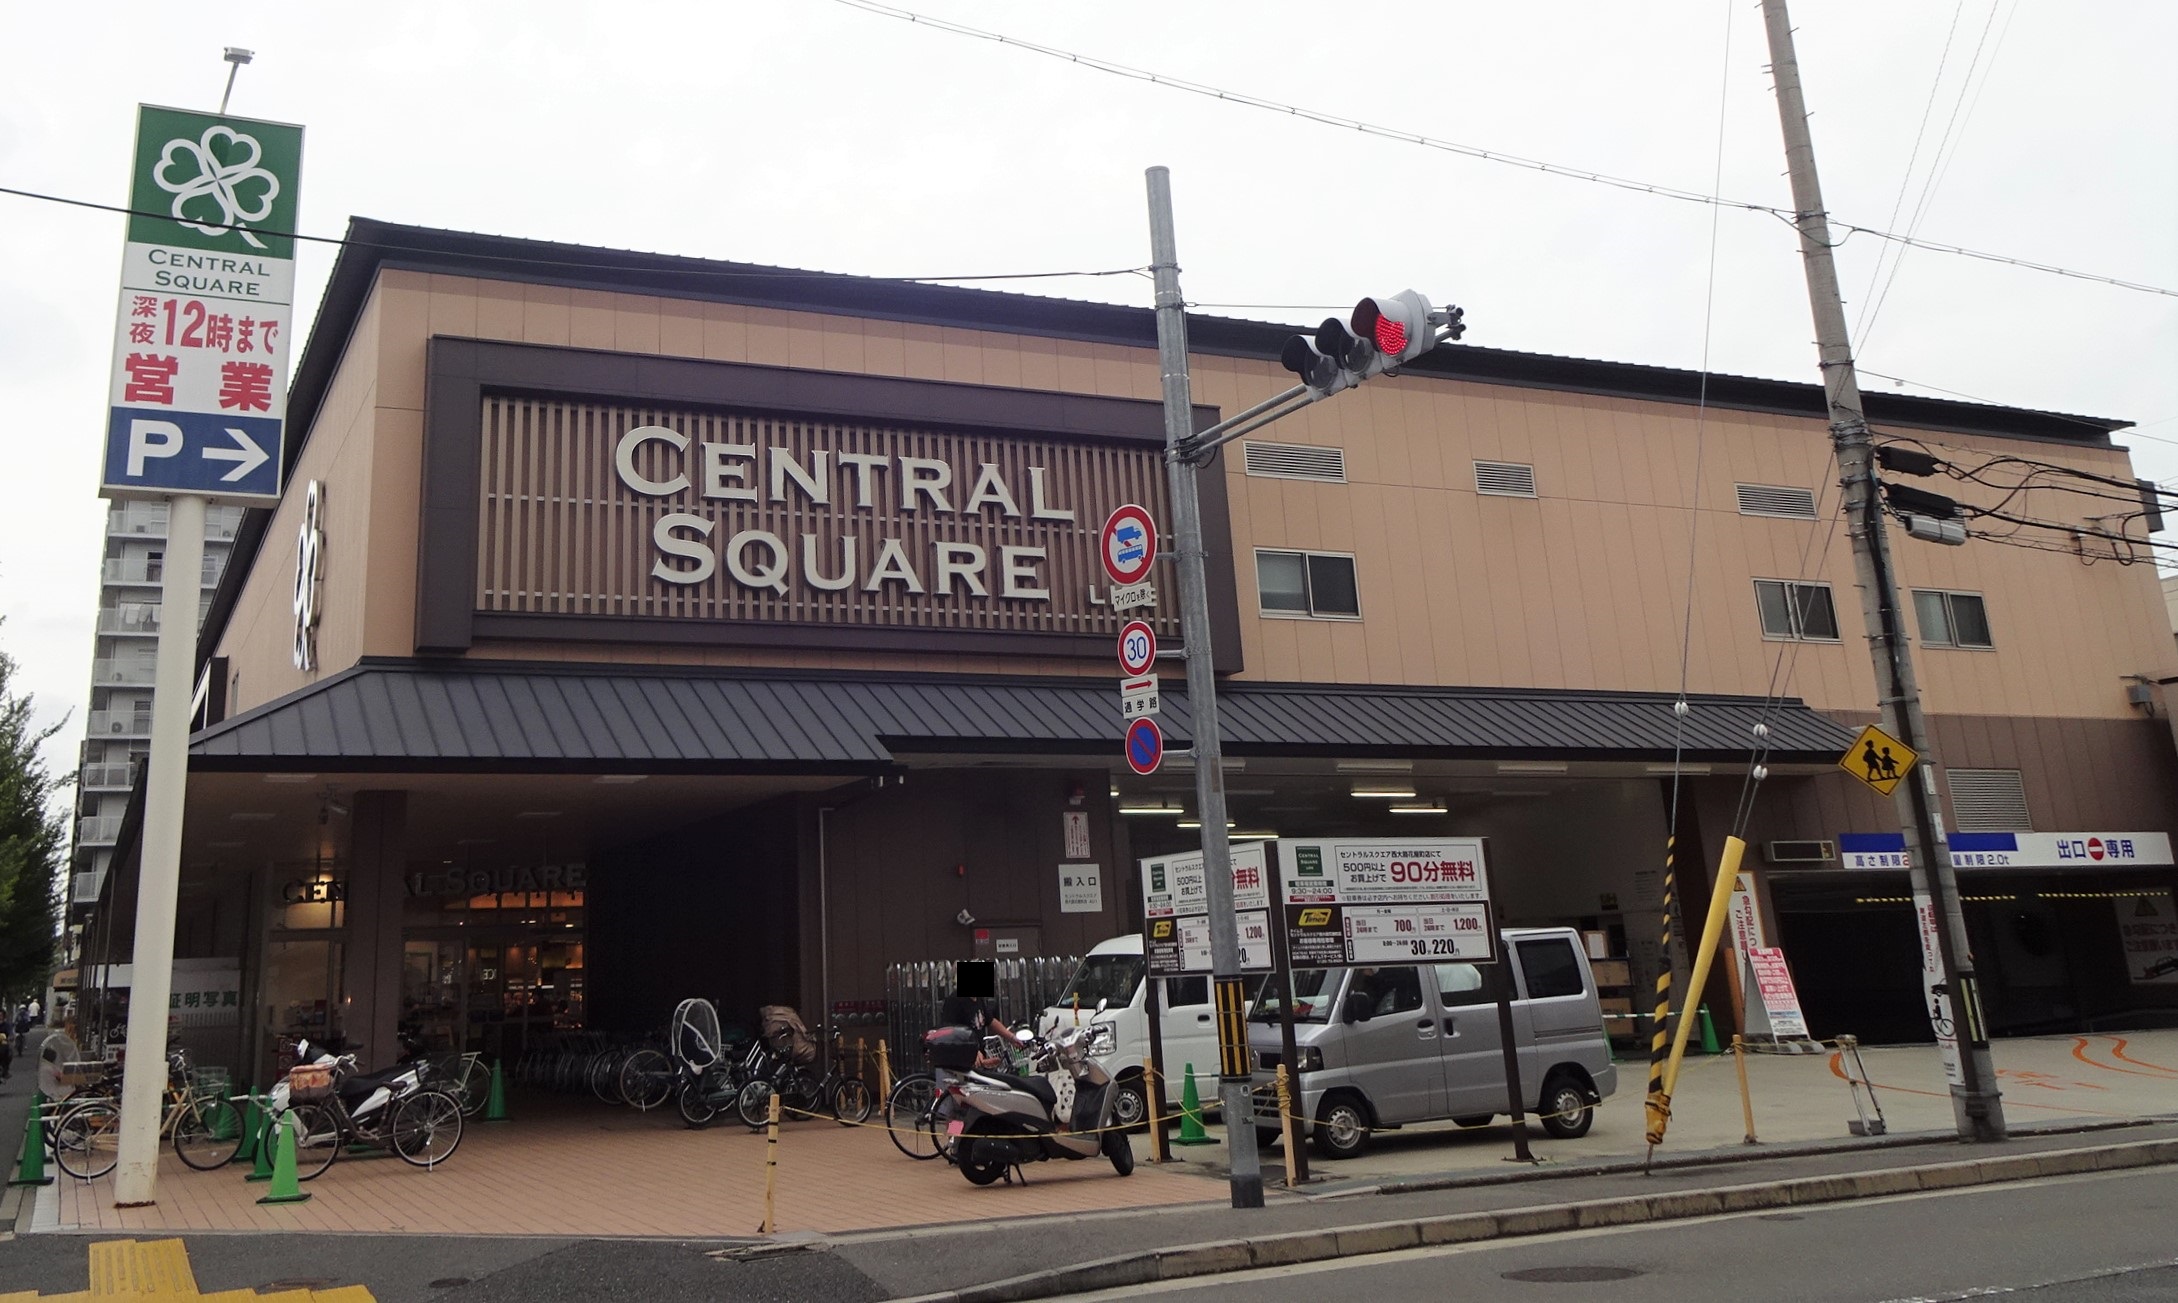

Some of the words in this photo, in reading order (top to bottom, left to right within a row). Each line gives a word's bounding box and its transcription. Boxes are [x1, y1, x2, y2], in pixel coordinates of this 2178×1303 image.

[148, 248, 271, 278] CENTRAL
[154, 270, 261, 297] SQUARE
[129, 295, 158, 346] 深夜
[162, 299, 280, 355] 12時まで
[124, 352, 274, 412] 営業
[126, 418, 185, 477] P
[615, 424, 1075, 524] CENTRAL
[651, 512, 1051, 603] SQUARE
[1114, 588, 1150, 607] マイクロを除く
[1126, 635, 1147, 662] 30
[1123, 696, 1158, 715] 通学路
[1855, 853, 1910, 867] 高さ制限2
[1952, 853, 2009, 867] 量制限2.0t
[2057, 839, 2086, 859] 出口
[2106, 839, 2135, 858] 専用
[447, 864, 587, 895] SQUARE
[1232, 865, 1260, 890] 無料
[1343, 862, 1386, 872] 500円以上
[1350, 873, 1387, 883] お買上げで
[1390, 860, 1475, 883] 90分無料
[1063, 876, 1097, 887] 搬入口
